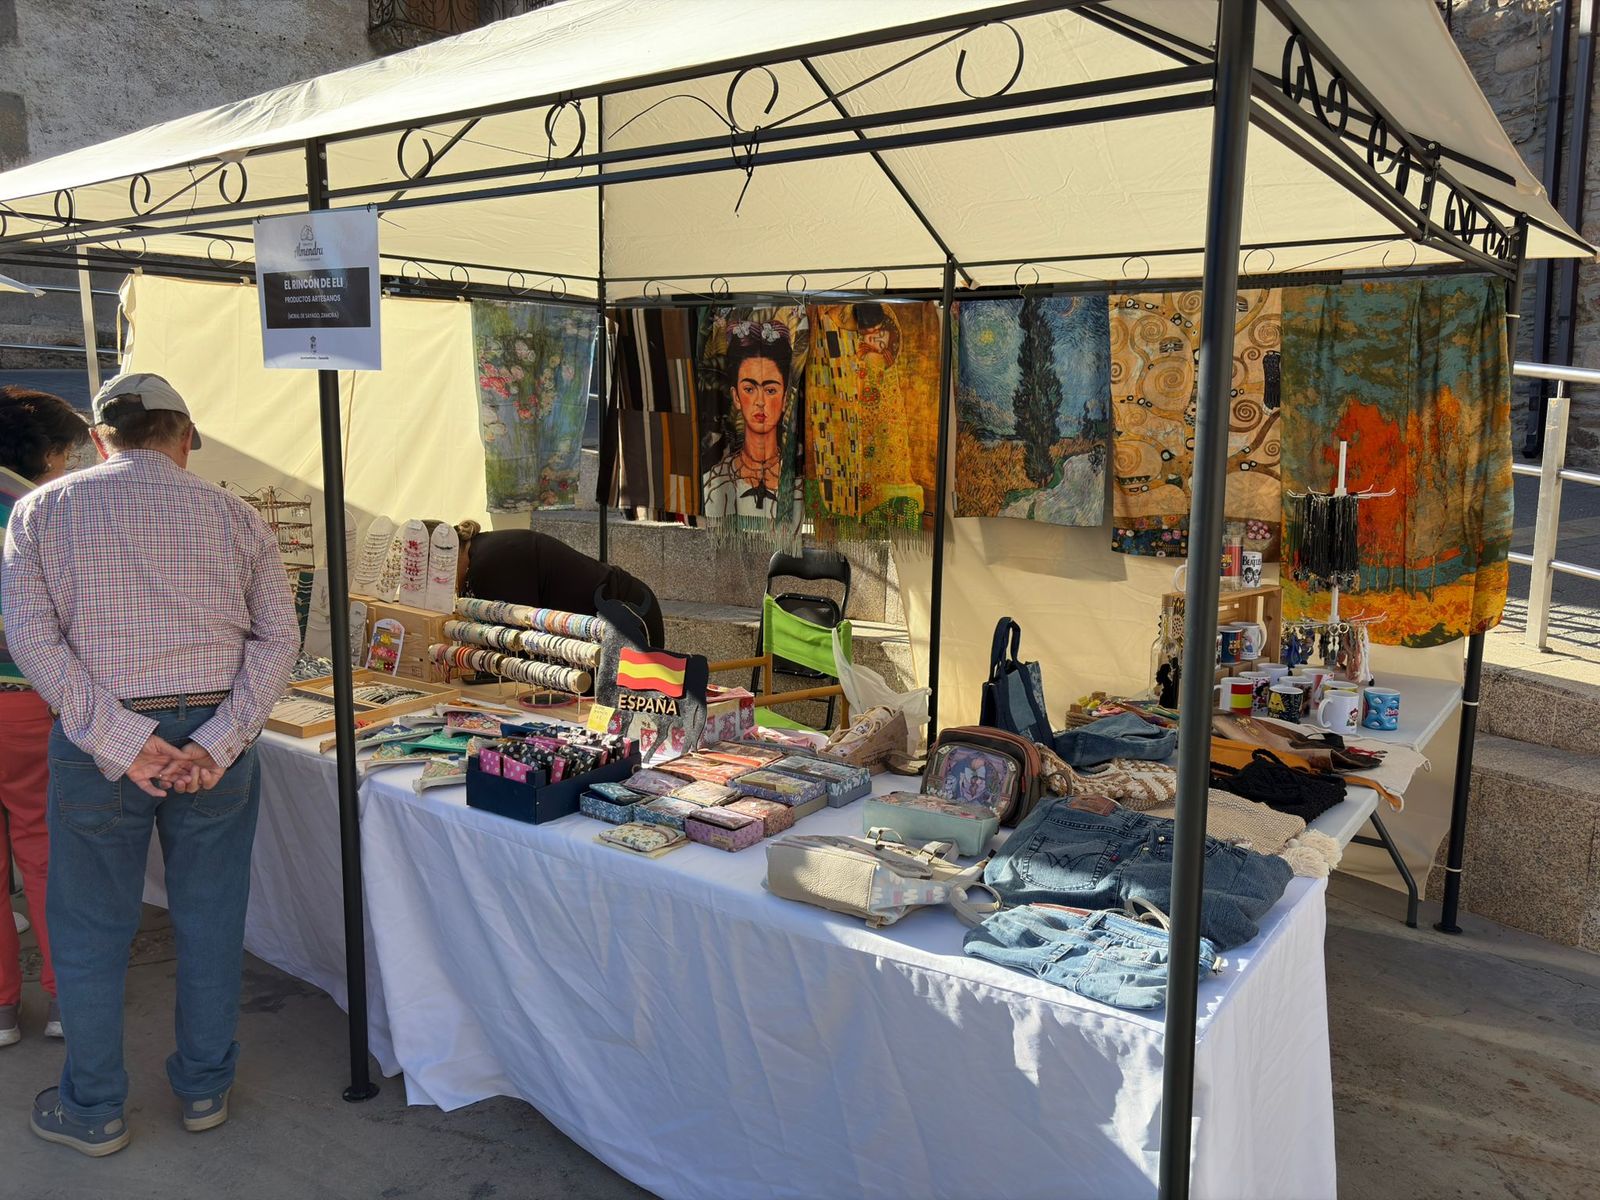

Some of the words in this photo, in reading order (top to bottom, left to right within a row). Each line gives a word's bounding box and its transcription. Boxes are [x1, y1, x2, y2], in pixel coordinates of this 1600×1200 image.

[284, 280, 291, 290] EL
[292, 276, 320, 289] RINCÓN
[321, 277, 331, 288] DE
[332, 277, 343, 288] ELI
[285, 295, 311, 303] PRODUCTOS
[312, 294, 340, 302] ARTESANOS
[618, 694, 678, 715] ESPAÑA
